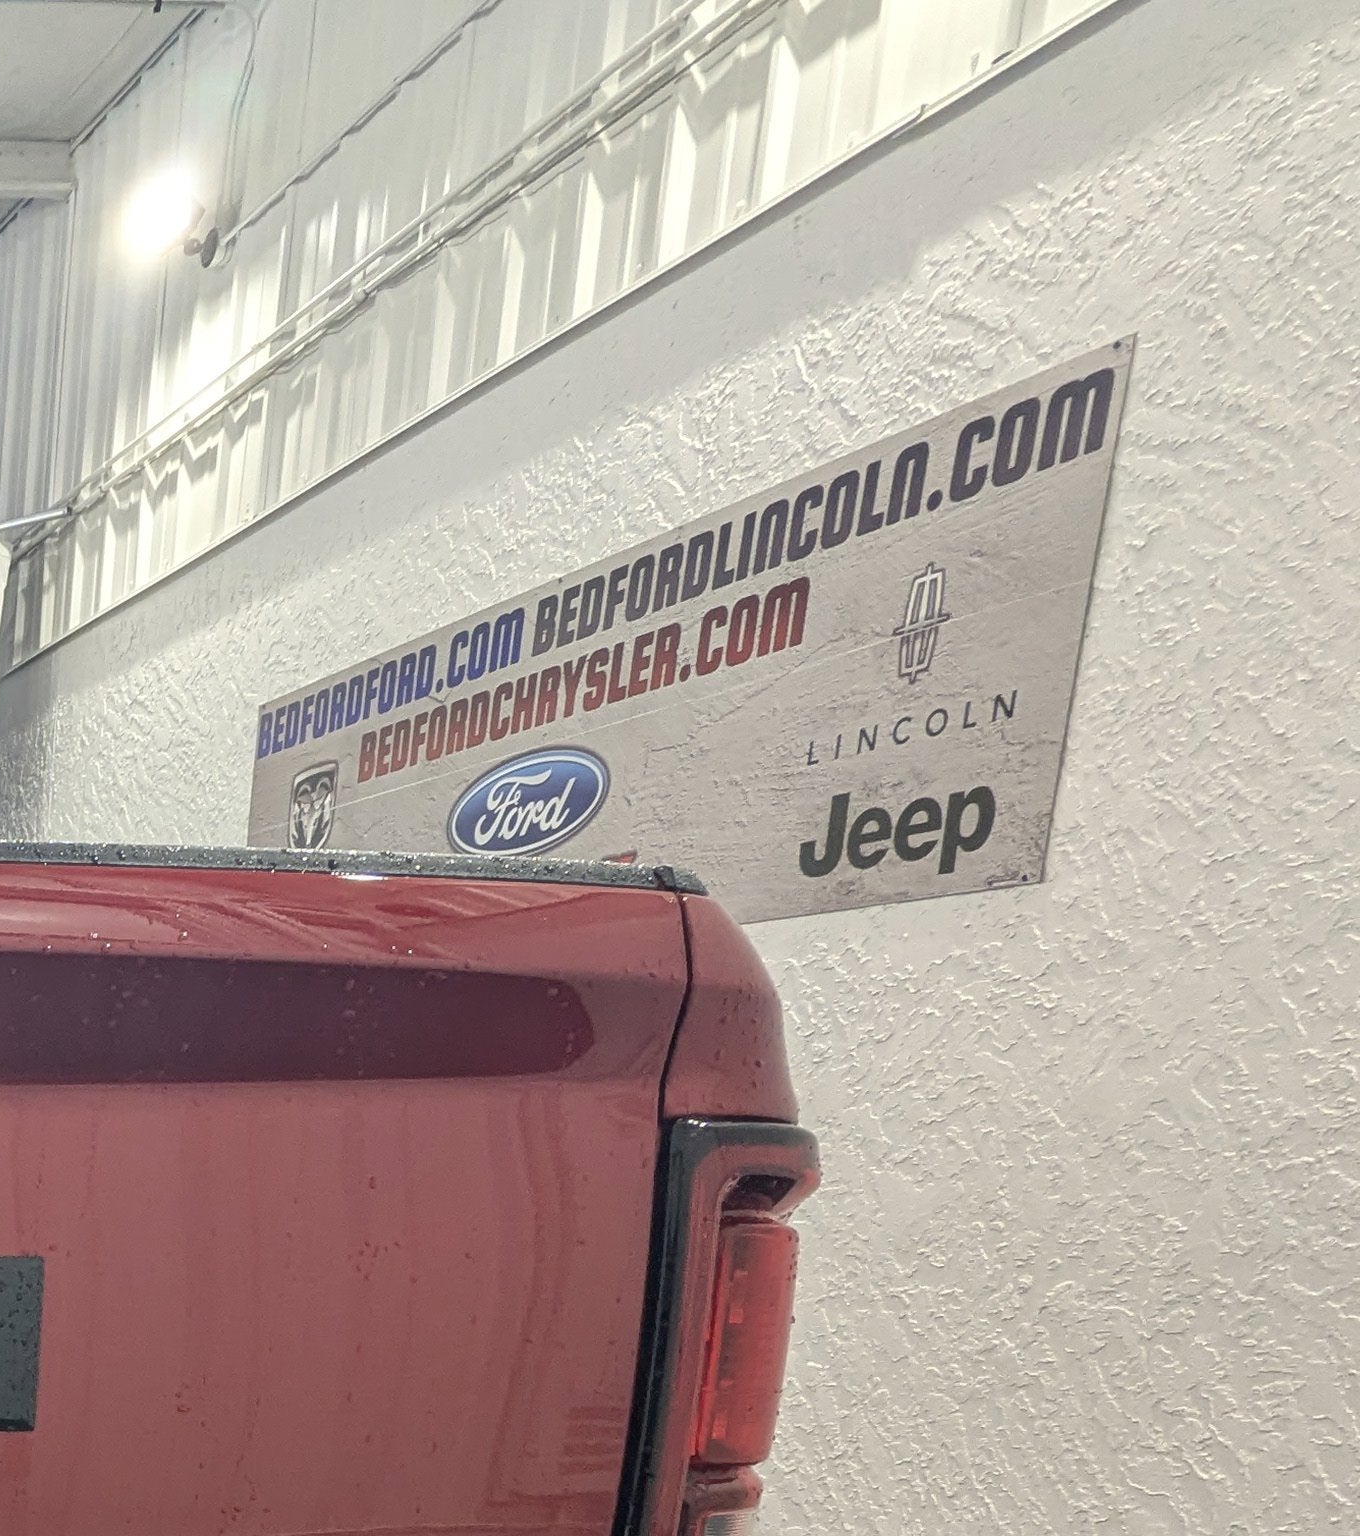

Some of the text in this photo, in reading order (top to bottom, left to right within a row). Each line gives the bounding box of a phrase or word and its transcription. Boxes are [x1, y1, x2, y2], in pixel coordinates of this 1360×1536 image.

[257, 367, 1116, 760] BEDFORDFORD.COM BEDFORDLINCOLN.COM
[357, 576, 811, 784] BEDFORDCHRYSLER.COM
[806, 689, 1018, 766] LINCOLN
[474, 766, 578, 846] Ford
[799, 785, 997, 878] Jeep
